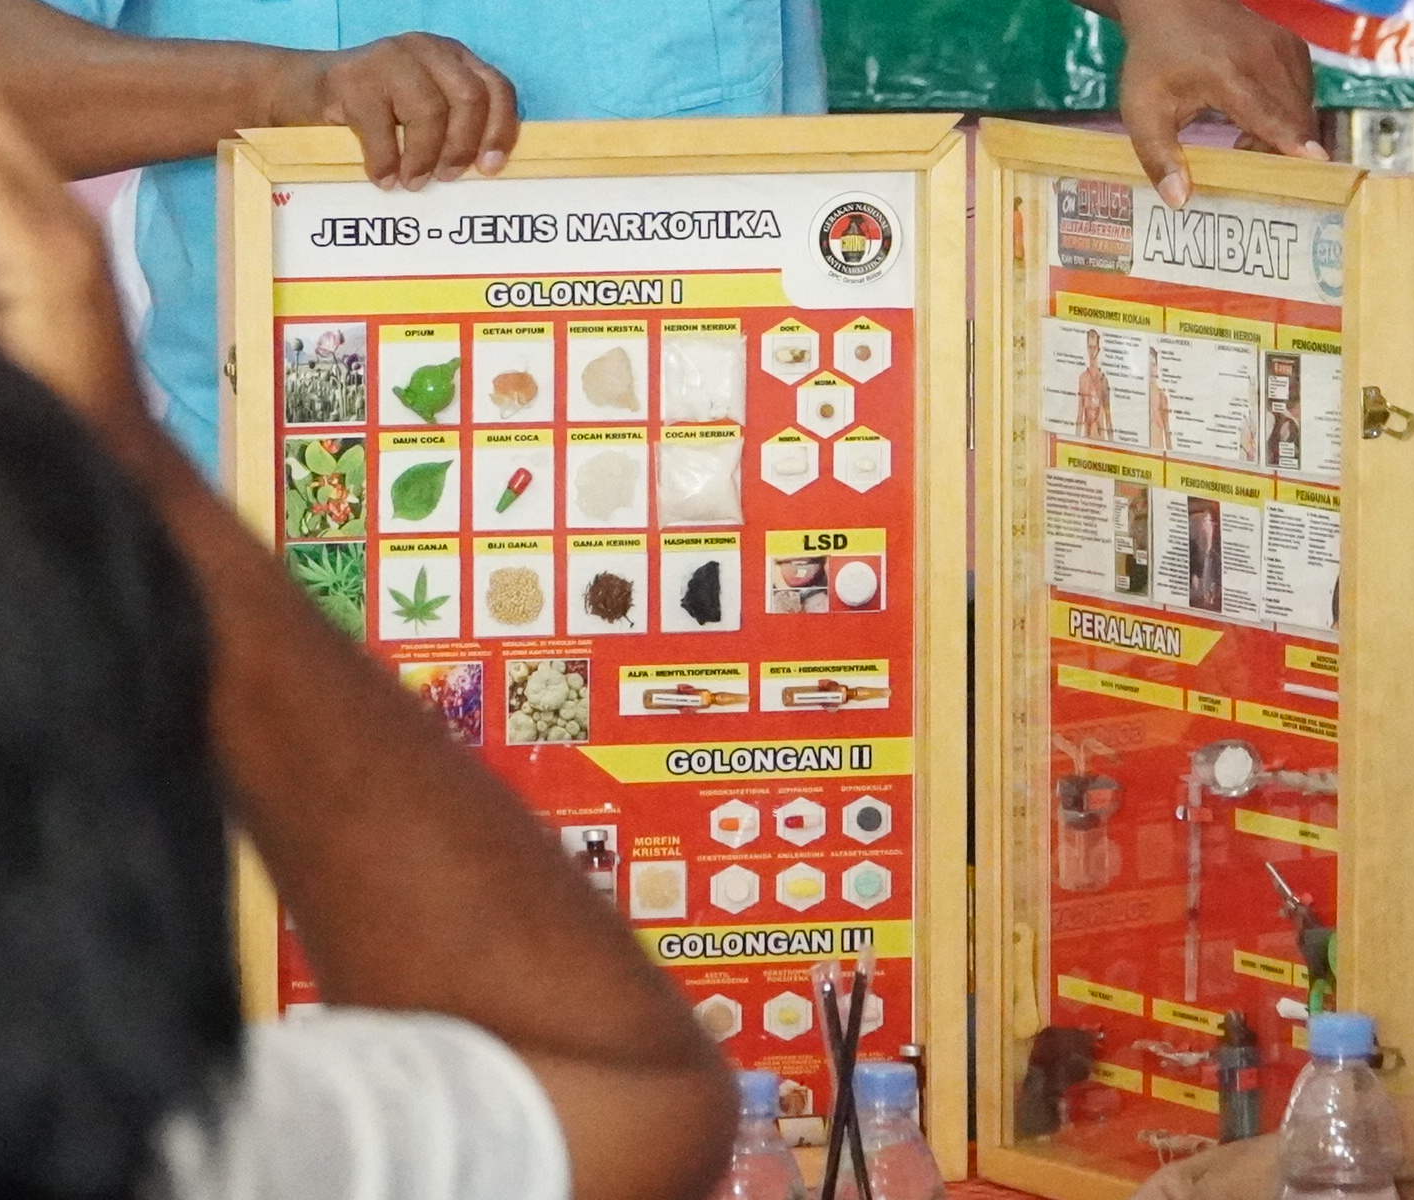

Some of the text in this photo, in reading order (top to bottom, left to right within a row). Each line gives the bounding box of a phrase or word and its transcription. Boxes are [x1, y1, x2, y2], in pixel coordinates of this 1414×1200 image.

[311, 216, 420, 247] JENIS
[449, 214, 558, 244] JENIS
[566, 210, 781, 242] NARKOTIKA
[1143, 205, 1299, 280] AKIBAT
[485, 278, 684, 308] GOLONGAN I
[1068, 305, 1151, 326] PENGONSUMSI KOKAIN
[404, 329, 435, 337] OPIUM
[482, 327, 545, 336] GETAH OPIUM
[569, 325, 645, 334] HEROIN KRISTAL
[664, 323, 738, 332] HEROIN SERBUK
[1179, 322, 1261, 344] PENGONSUMSI HEROIN
[487, 434, 540, 443] BUAH COCA
[605, 432, 644, 440] KRISTAL
[699, 430, 736, 438] SERBUK
[392, 436, 446, 445] DAUN COCA
[1068, 457, 1152, 480] PENGONSUMSI EKSTASI
[1180, 476, 1260, 499] PENGONSUMSI SHABU
[487, 541, 539, 550] BIJI GANJA
[573, 539, 641, 548] GANJA KERING
[704, 537, 737, 545] KERING
[803, 533, 849, 551] LSD
[390, 543, 449, 552] DAUN GANJA
[1069, 607, 1182, 658] PERALATAN
[667, 745, 873, 776] GOLONGAN II
[634, 835, 681, 846] MORFIN
[632, 846, 682, 858] KRISTAL
[659, 930, 833, 959] GOLONGAN
